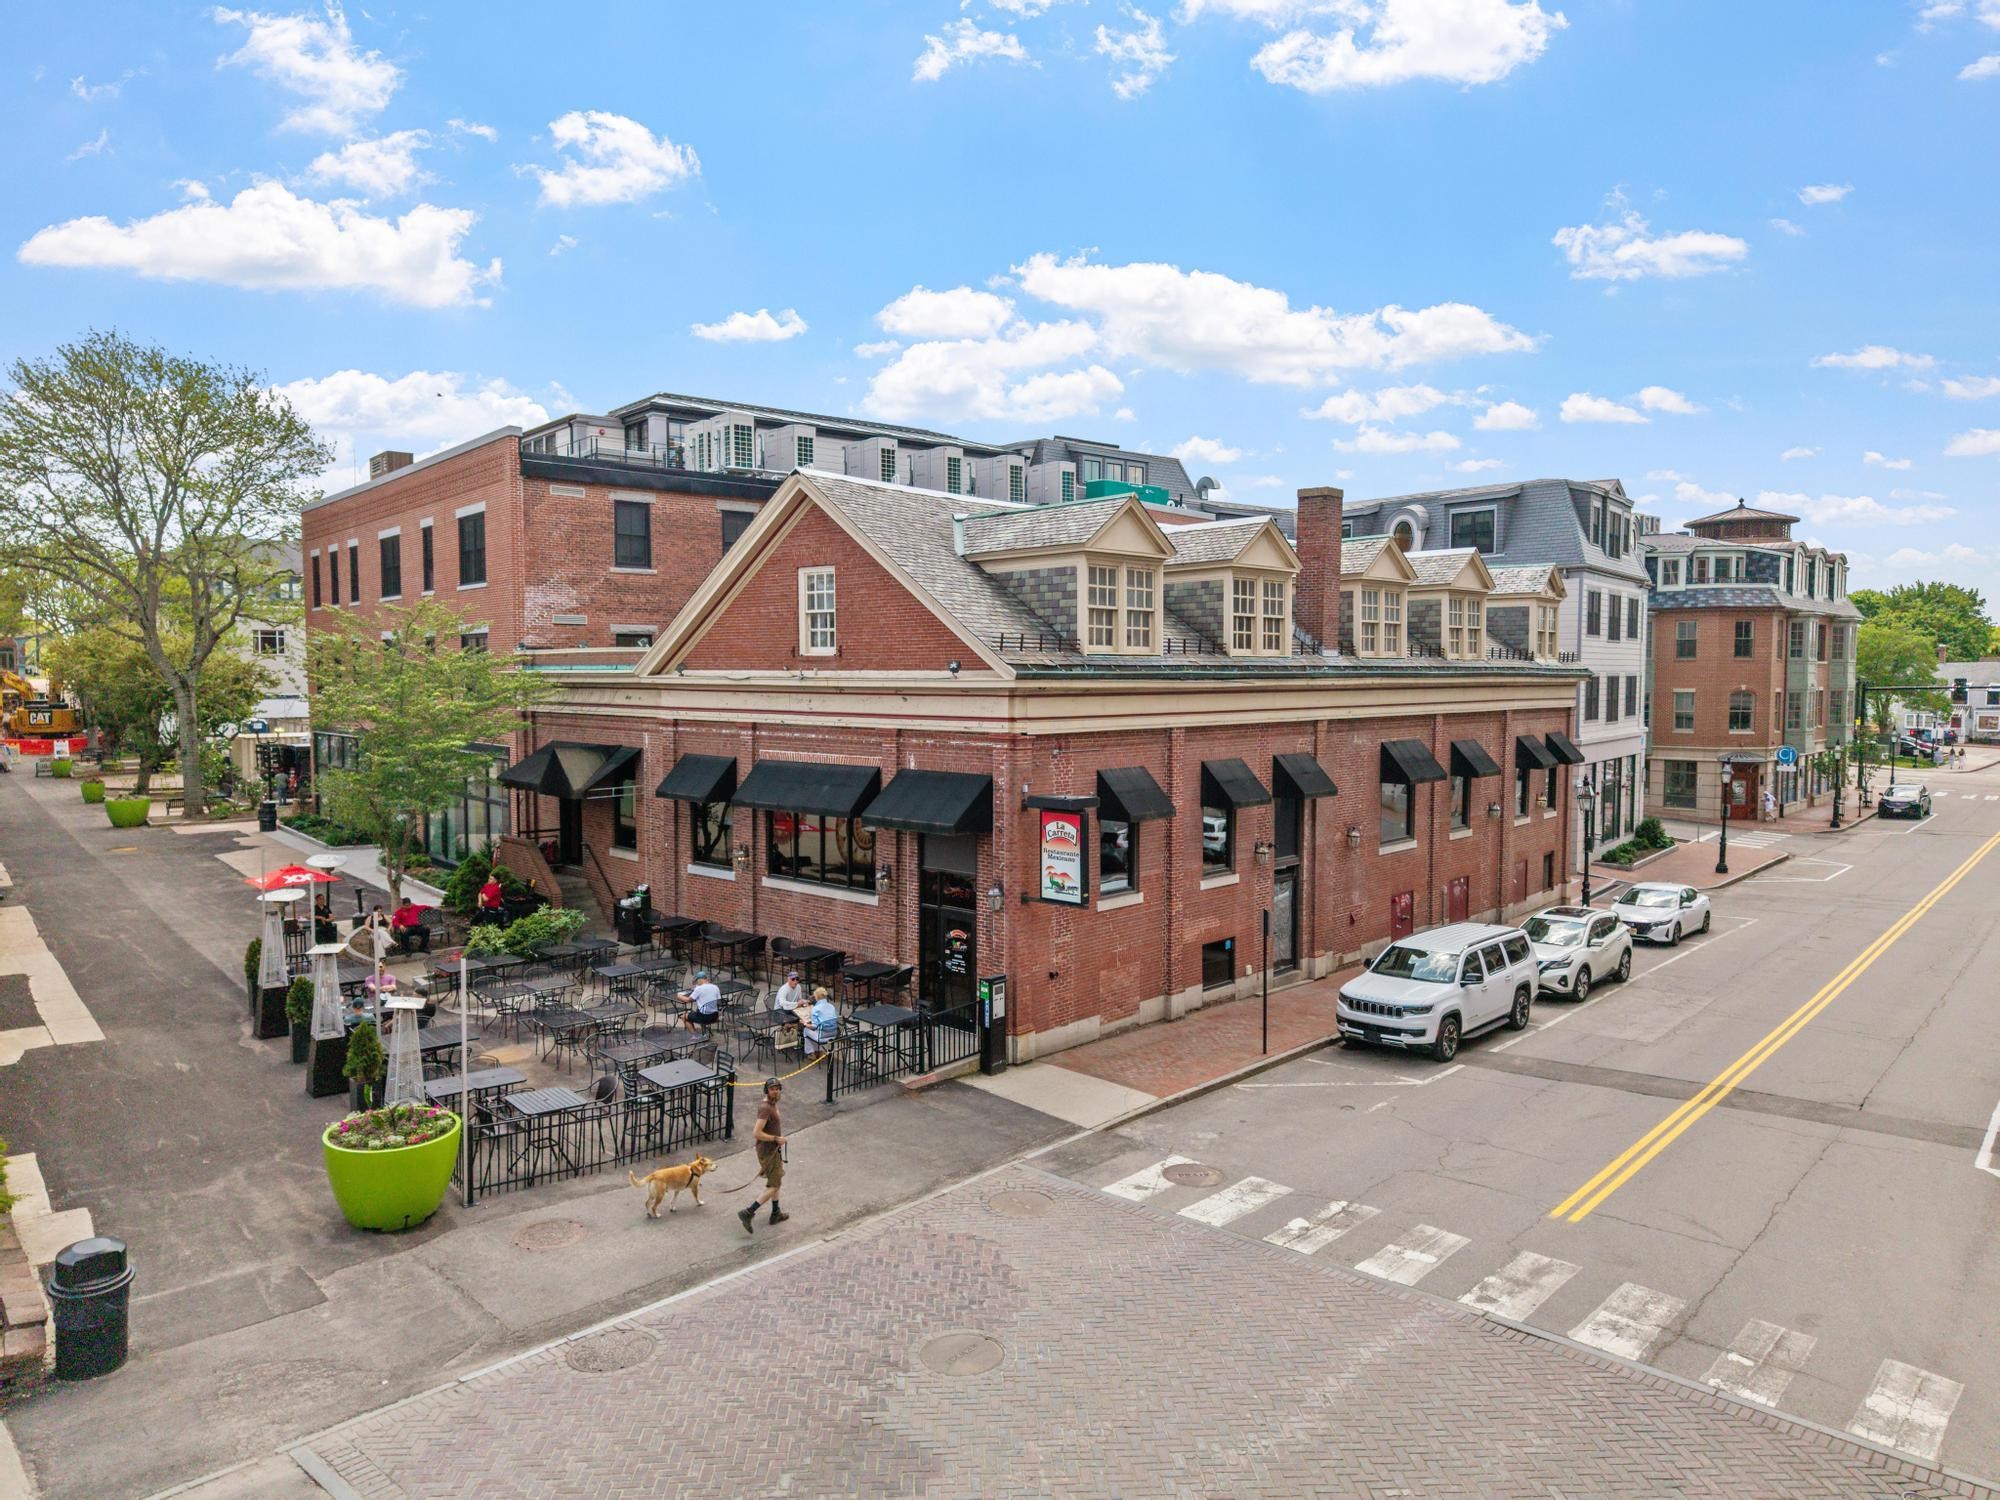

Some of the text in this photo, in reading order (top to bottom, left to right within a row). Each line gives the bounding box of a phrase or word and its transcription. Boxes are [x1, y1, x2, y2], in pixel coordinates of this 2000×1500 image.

[29, 712, 51, 725] CAT
[1056, 822, 1065, 830] La
[1047, 830, 1075, 840] Carreta
